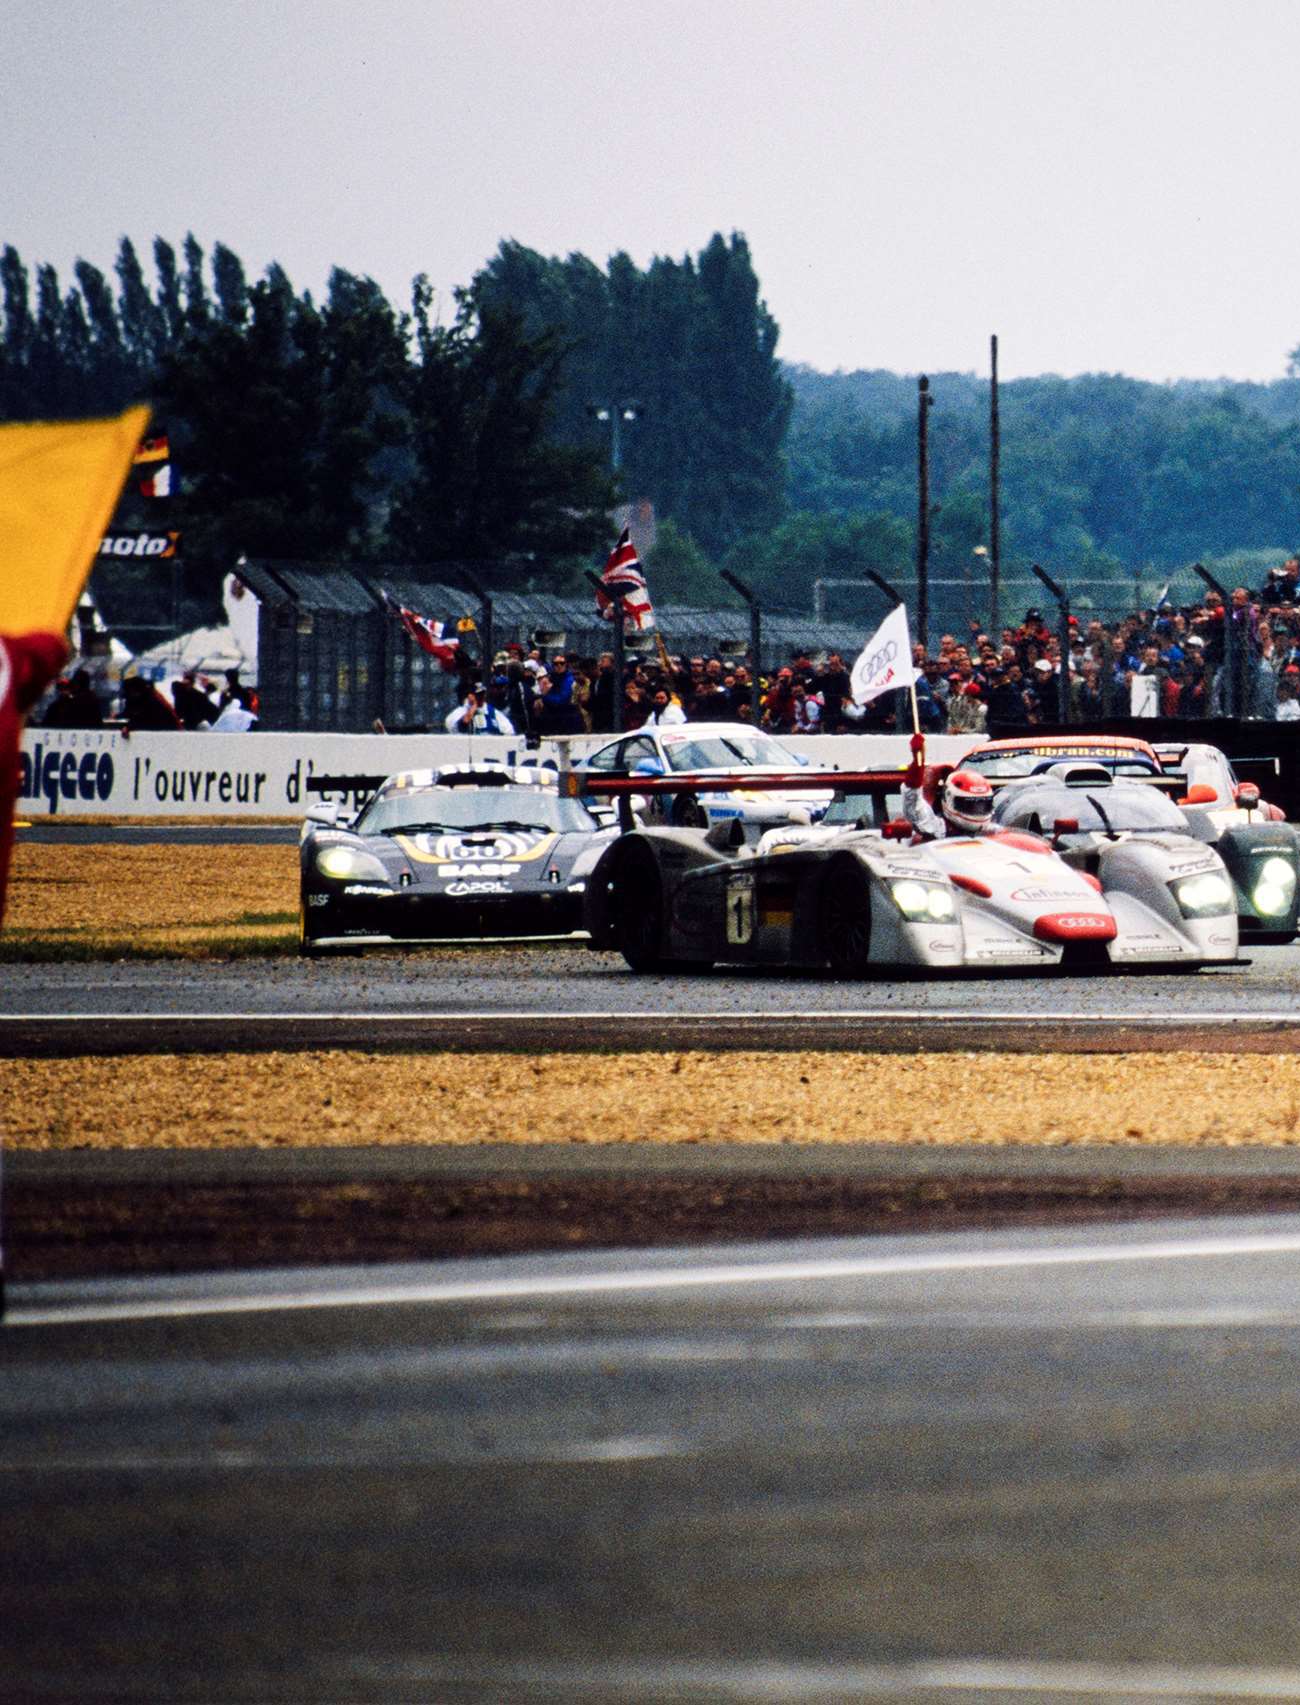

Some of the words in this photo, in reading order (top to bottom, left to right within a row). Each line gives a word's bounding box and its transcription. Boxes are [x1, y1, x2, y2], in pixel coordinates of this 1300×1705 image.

[133, 757, 267, 803] l'ouvreur
[437, 863, 522, 877] BASF
[732, 896, 743, 938] 1
